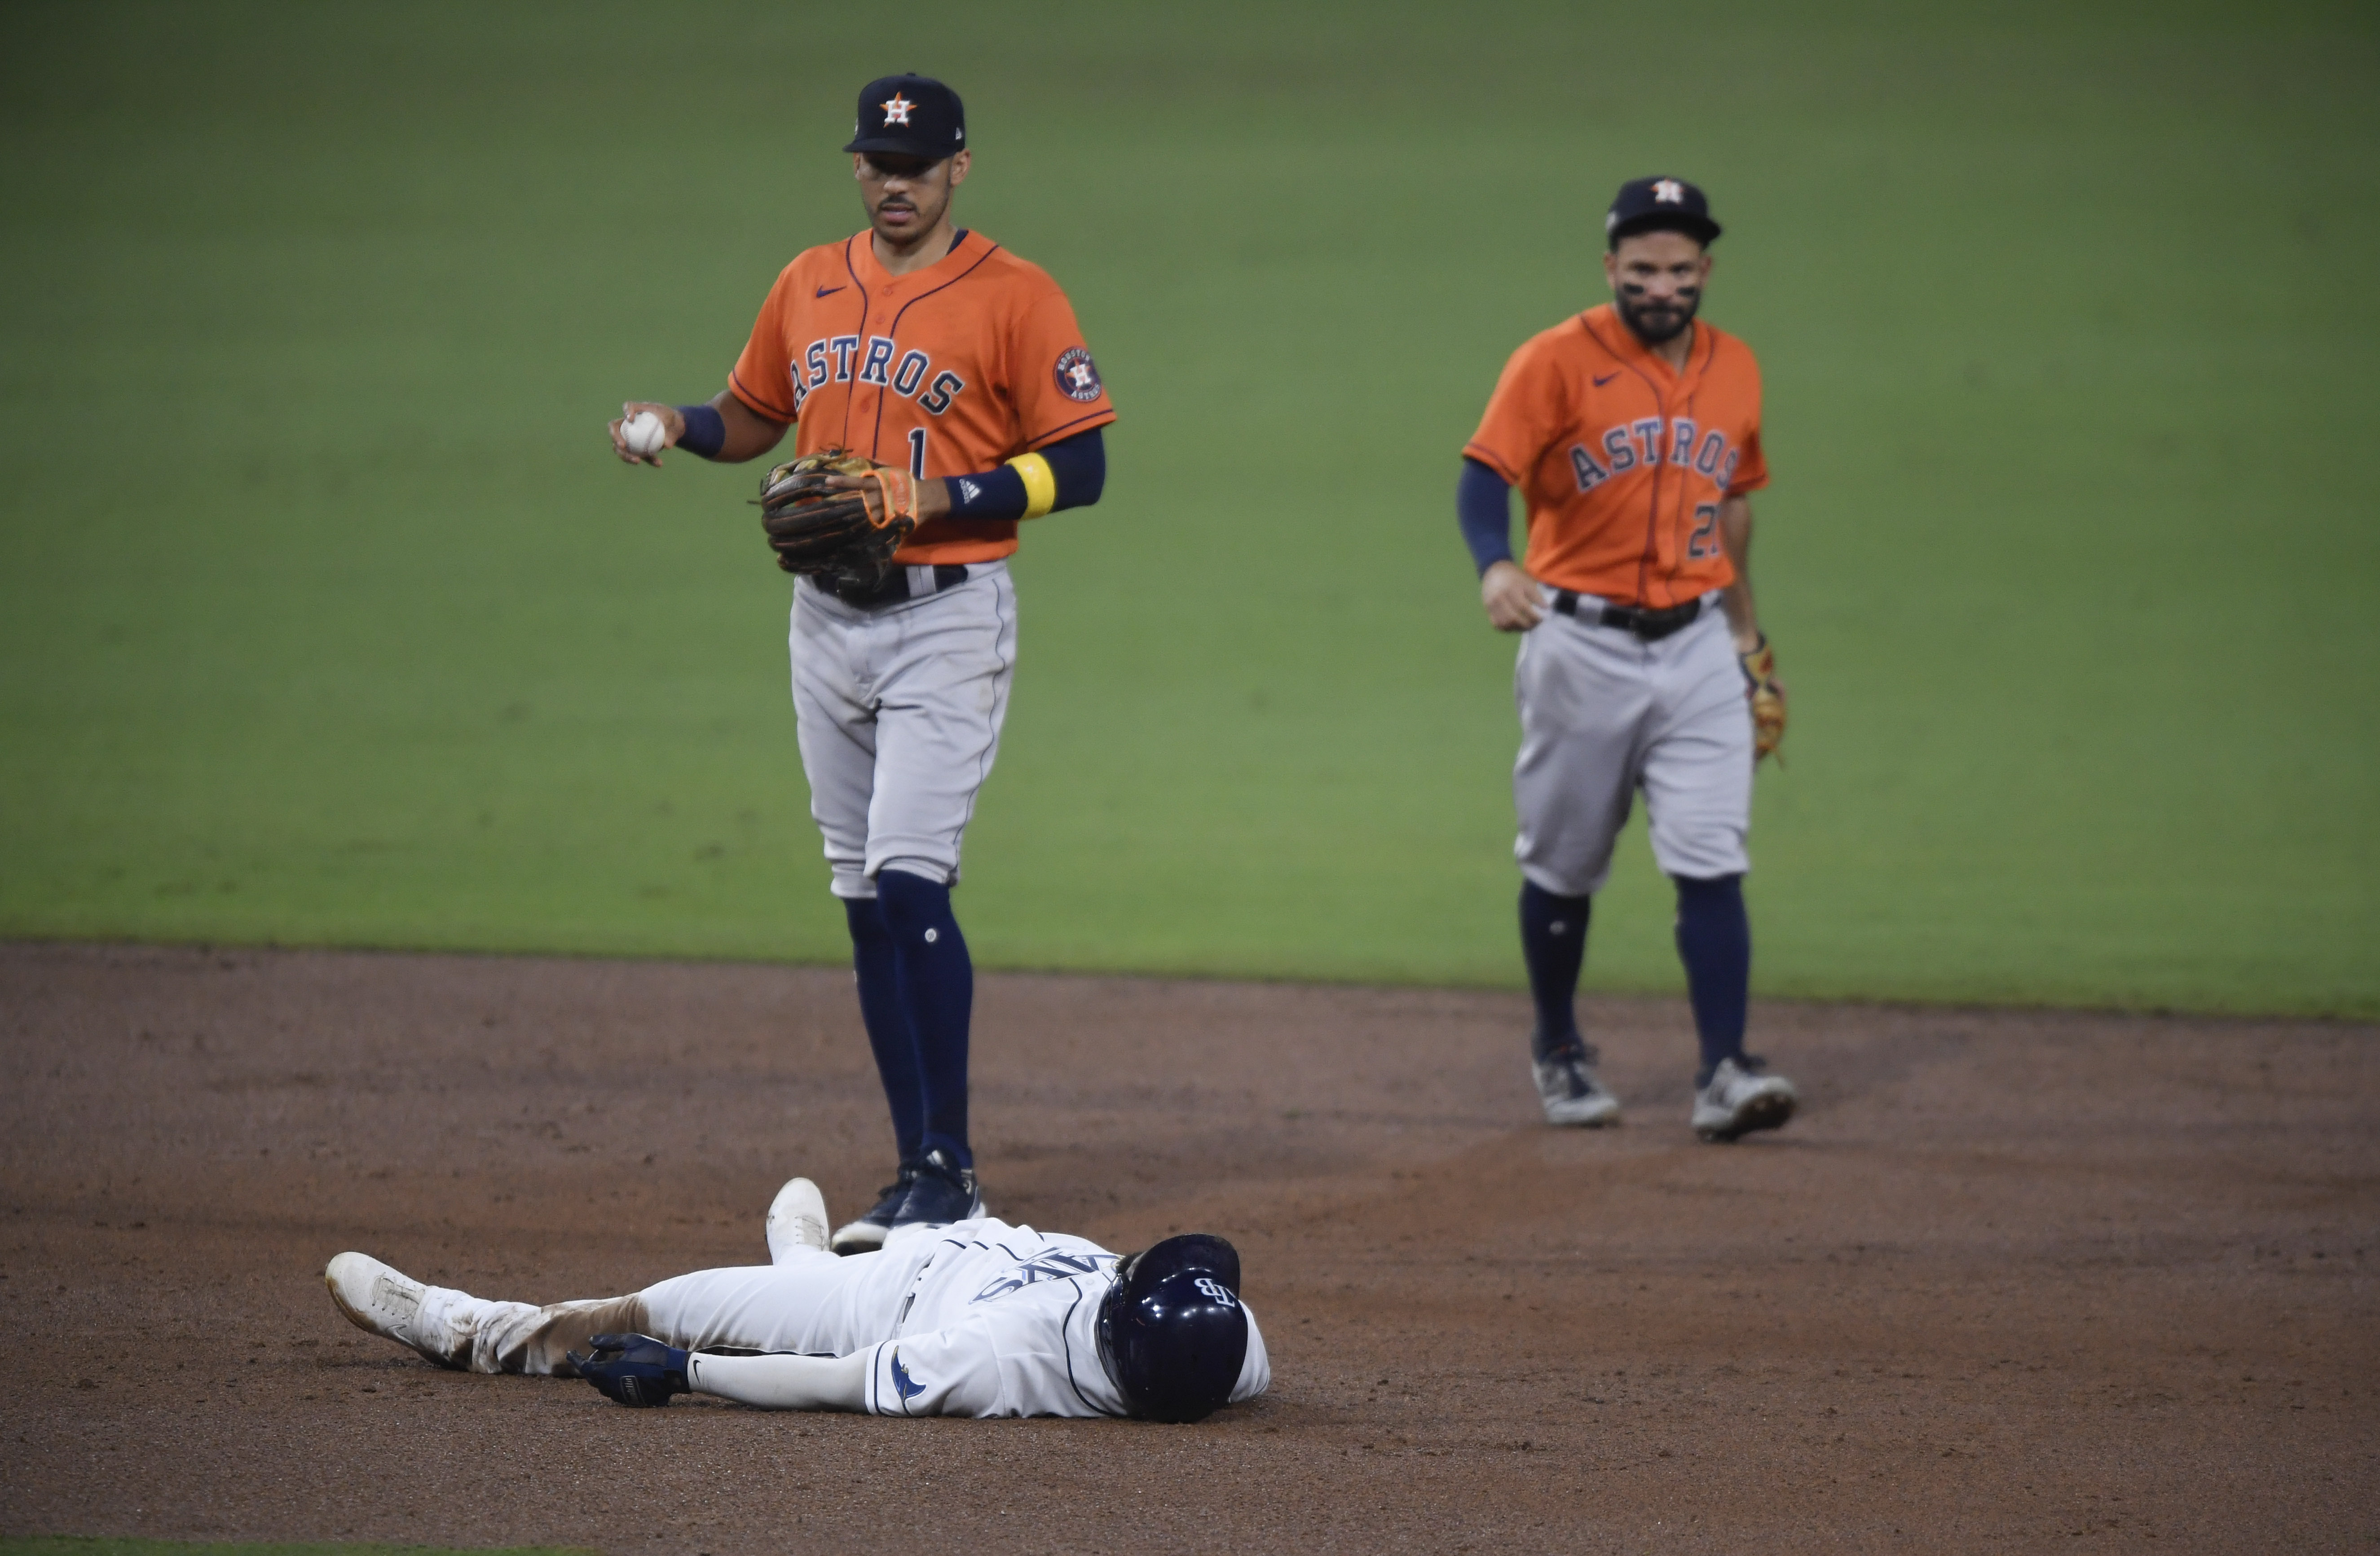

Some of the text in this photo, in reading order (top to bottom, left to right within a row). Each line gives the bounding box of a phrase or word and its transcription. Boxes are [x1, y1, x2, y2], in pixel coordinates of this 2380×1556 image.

[884, 99, 910, 123] H
[790, 335, 965, 415] ASTROS
[1058, 349, 1091, 371] HOUSTON
[1071, 383, 1100, 400] ASTROS
[908, 427, 926, 480] 1
[1569, 416, 1738, 492] ASTROS
[959, 478, 970, 504] adidas
[968, 1246, 1126, 1305] AYS
